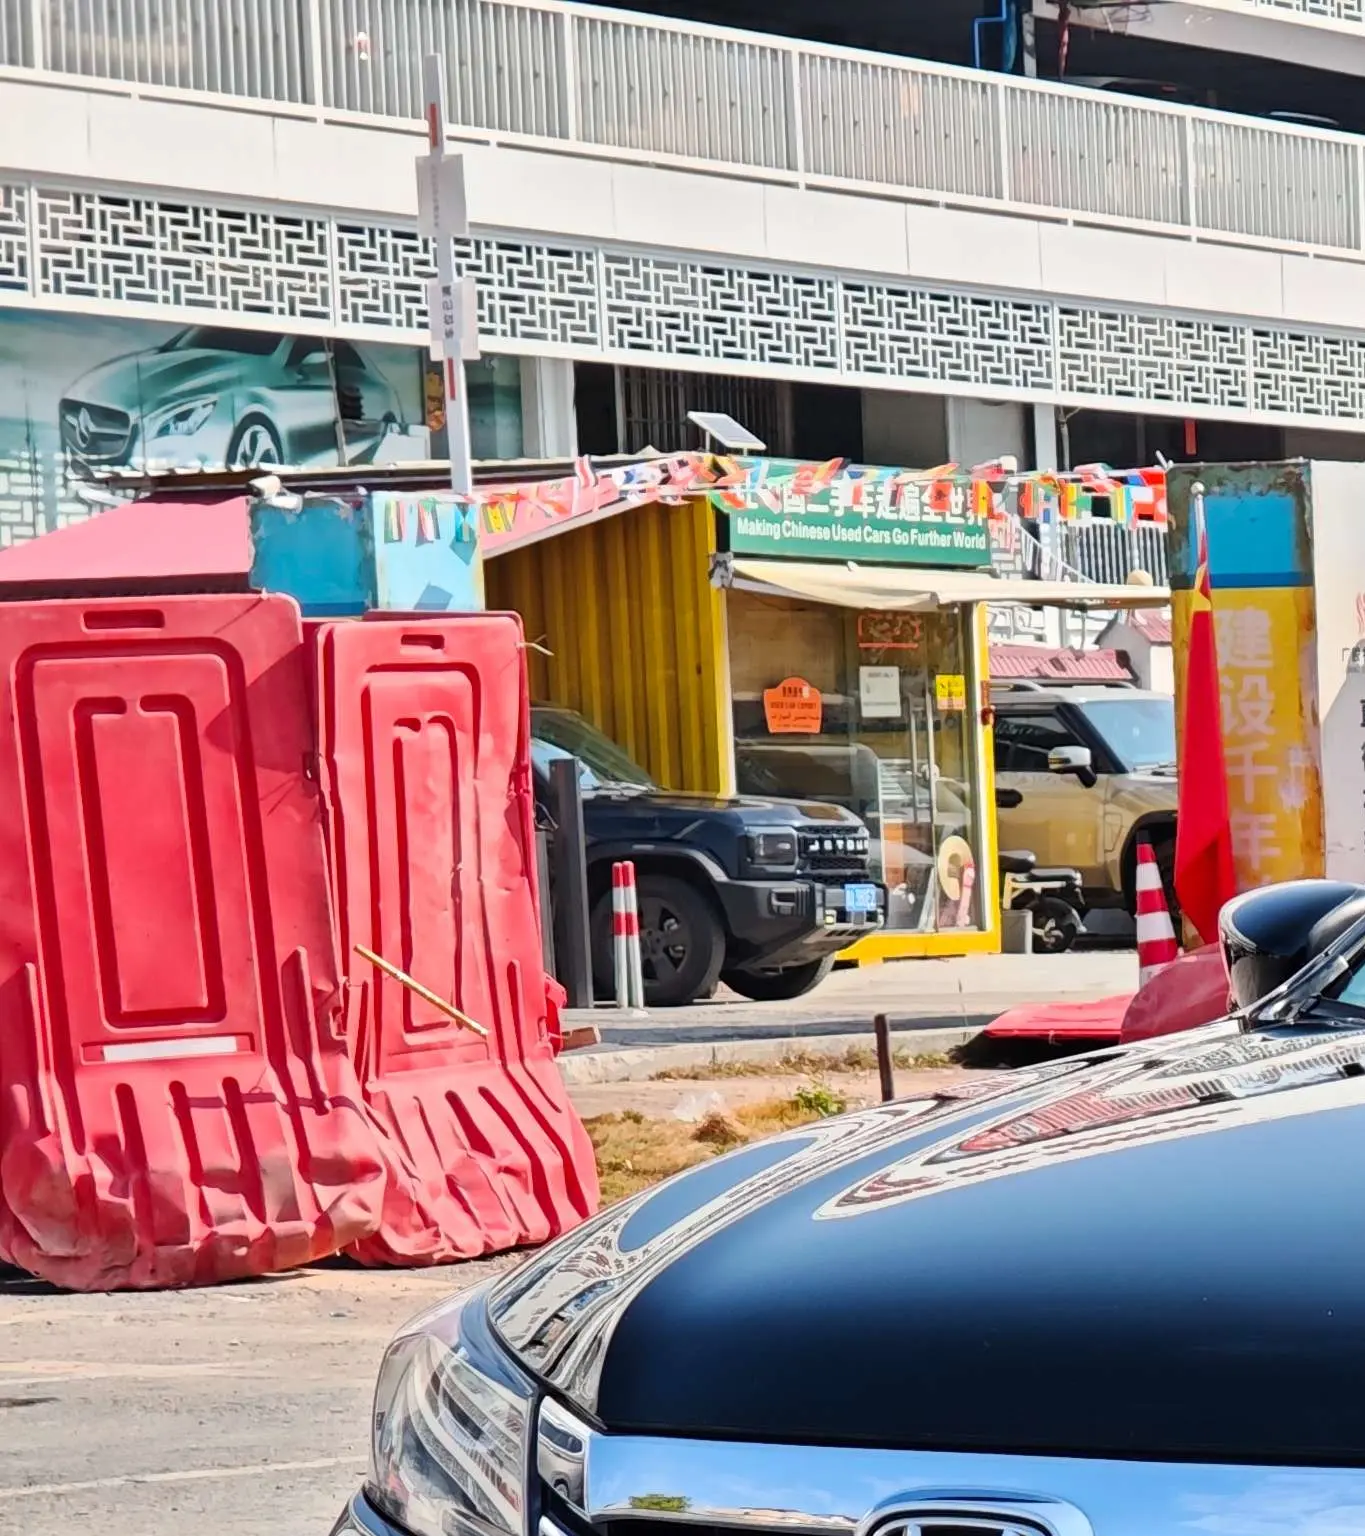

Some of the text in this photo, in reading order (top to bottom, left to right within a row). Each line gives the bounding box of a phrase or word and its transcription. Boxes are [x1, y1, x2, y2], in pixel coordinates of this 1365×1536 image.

[737, 518, 986, 550] Making Chinese Used Cars Go Further World
